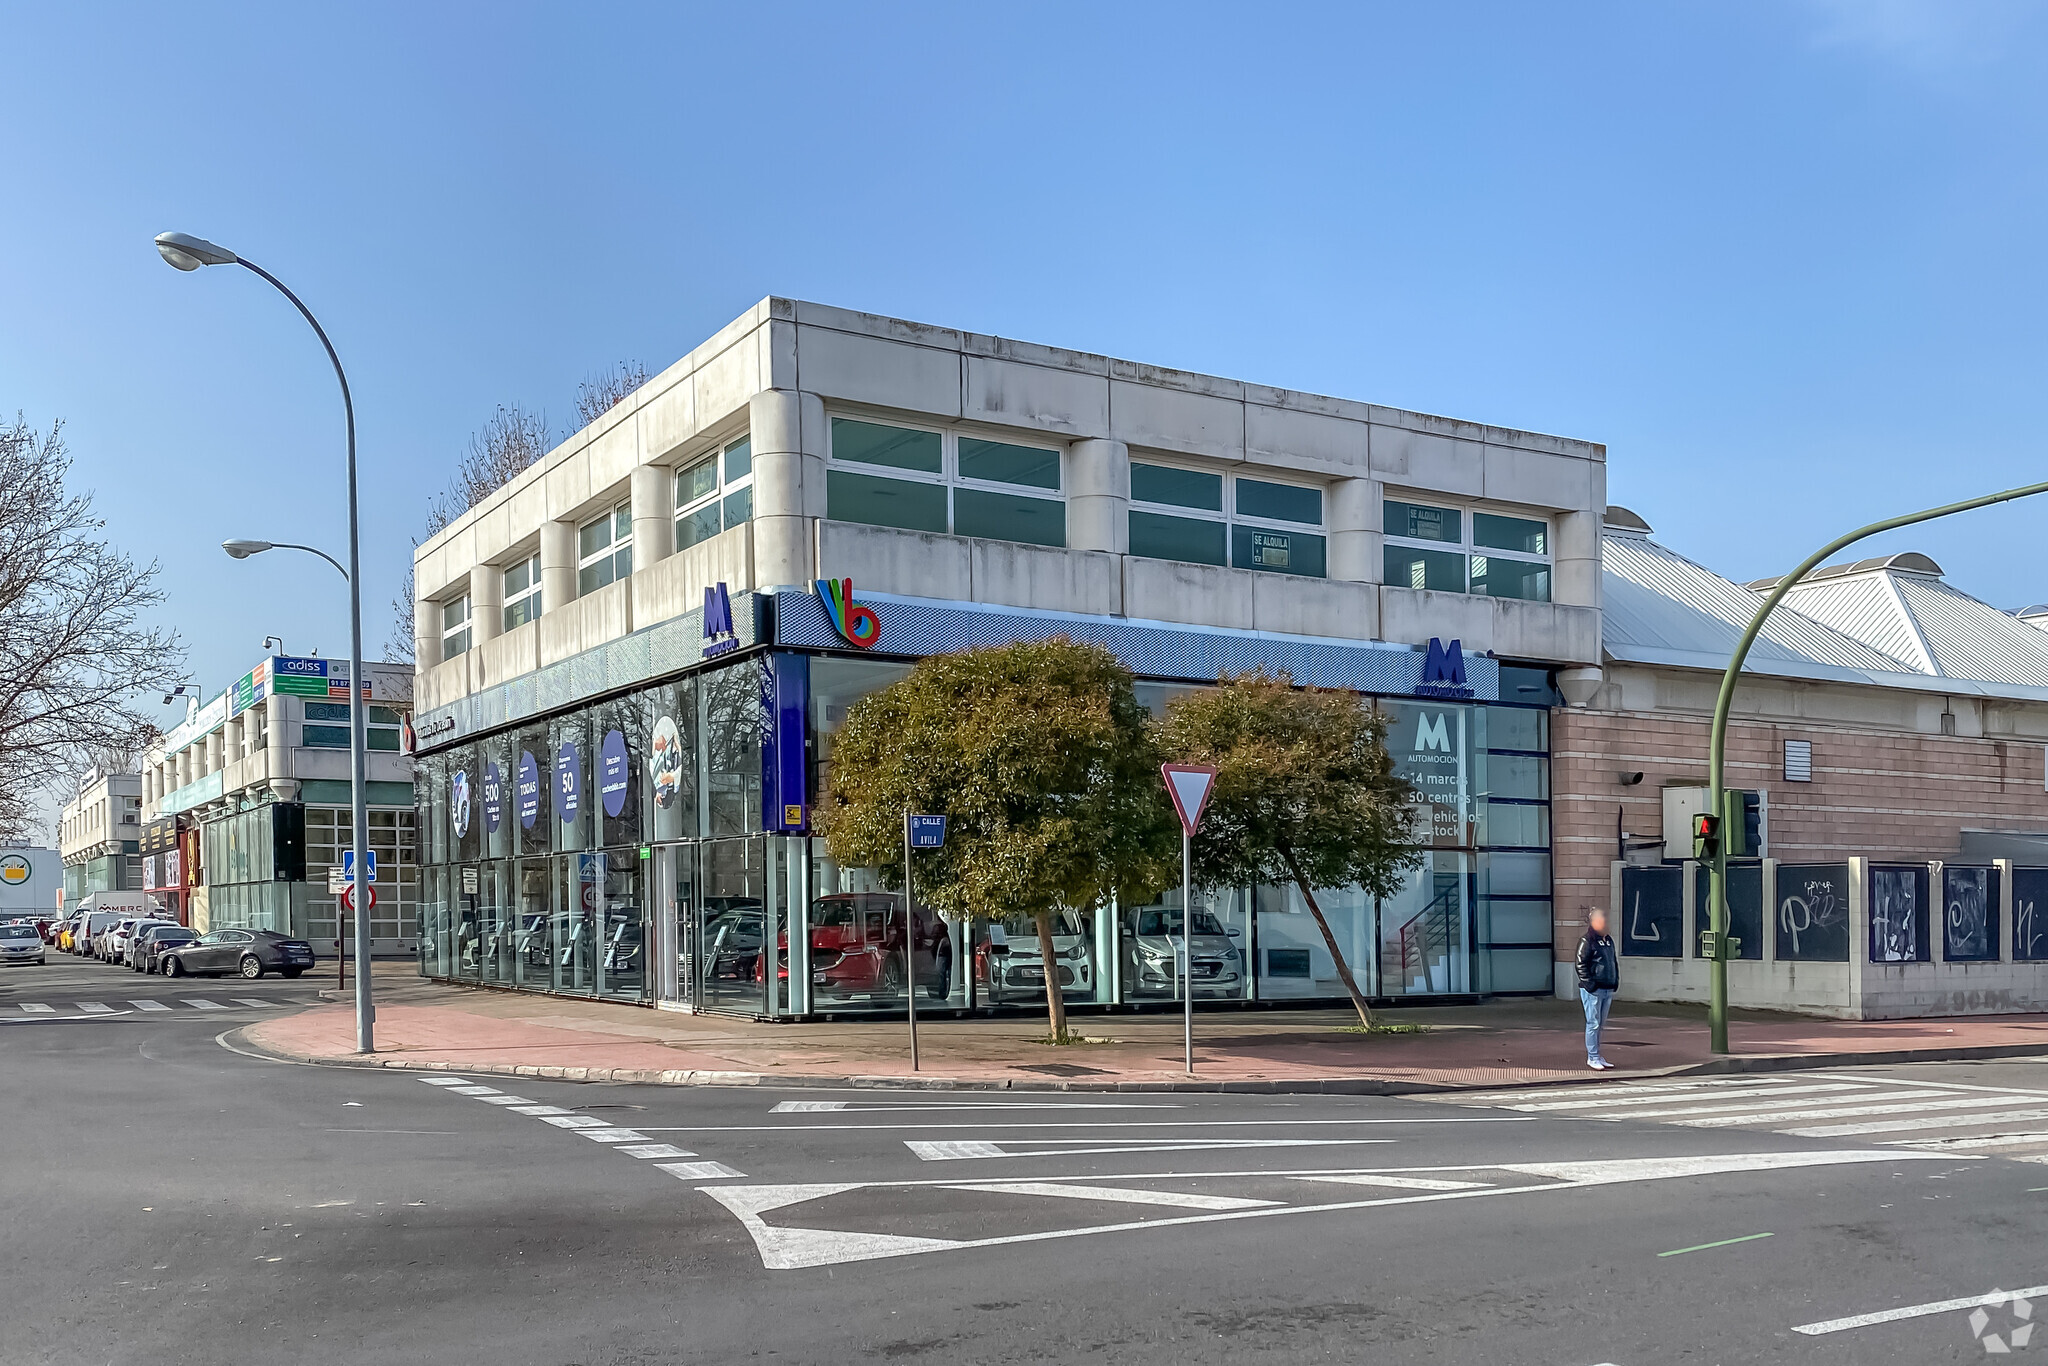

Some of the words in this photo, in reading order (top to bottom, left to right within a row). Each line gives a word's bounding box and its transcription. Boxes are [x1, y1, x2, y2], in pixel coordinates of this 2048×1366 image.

[1410, 508, 1417, 518] SE
[1418, 509, 1440, 521] ALQUILA
[1254, 535, 1262, 545] SE
[1263, 536, 1287, 548] ALQUILA
[704, 582, 734, 638] M
[283, 660, 320, 671] adiss
[1423, 637, 1467, 685] M
[1414, 711, 1451, 752] M
[562, 772, 573, 793] 50
[1410, 772, 1423, 784] 14
[485, 783, 499, 802] 500
[520, 781, 536, 796] TODAS
[1409, 791, 1424, 803] 50
[1428, 792, 1471, 804] centros
[921, 836, 936, 844] AVILA
